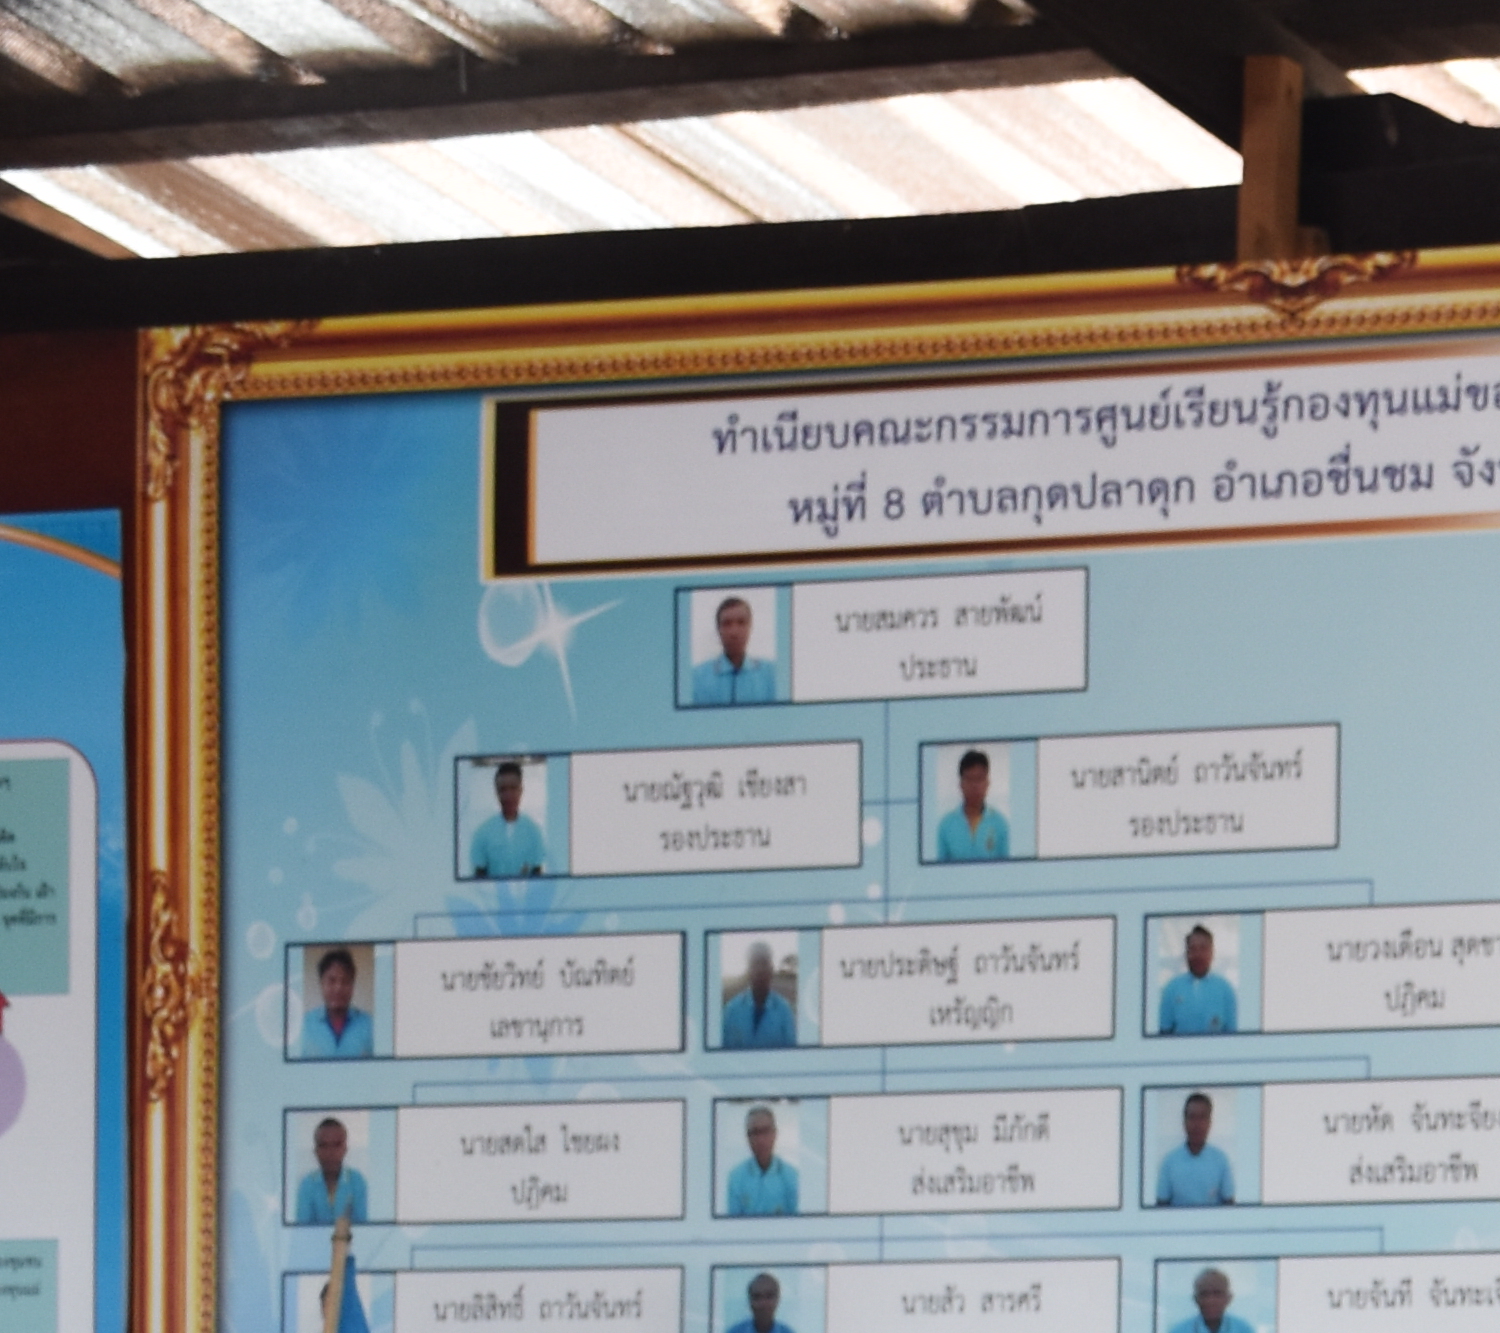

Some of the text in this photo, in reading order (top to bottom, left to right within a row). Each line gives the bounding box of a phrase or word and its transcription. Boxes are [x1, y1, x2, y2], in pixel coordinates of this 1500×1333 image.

[788, 471, 866, 538] หมู่ที่
[884, 488, 905, 521] 8
[922, 473, 1194, 524] ตำบลกุดปลาดุก
[1213, 446, 1434, 503] อำเภอชื่นชม
